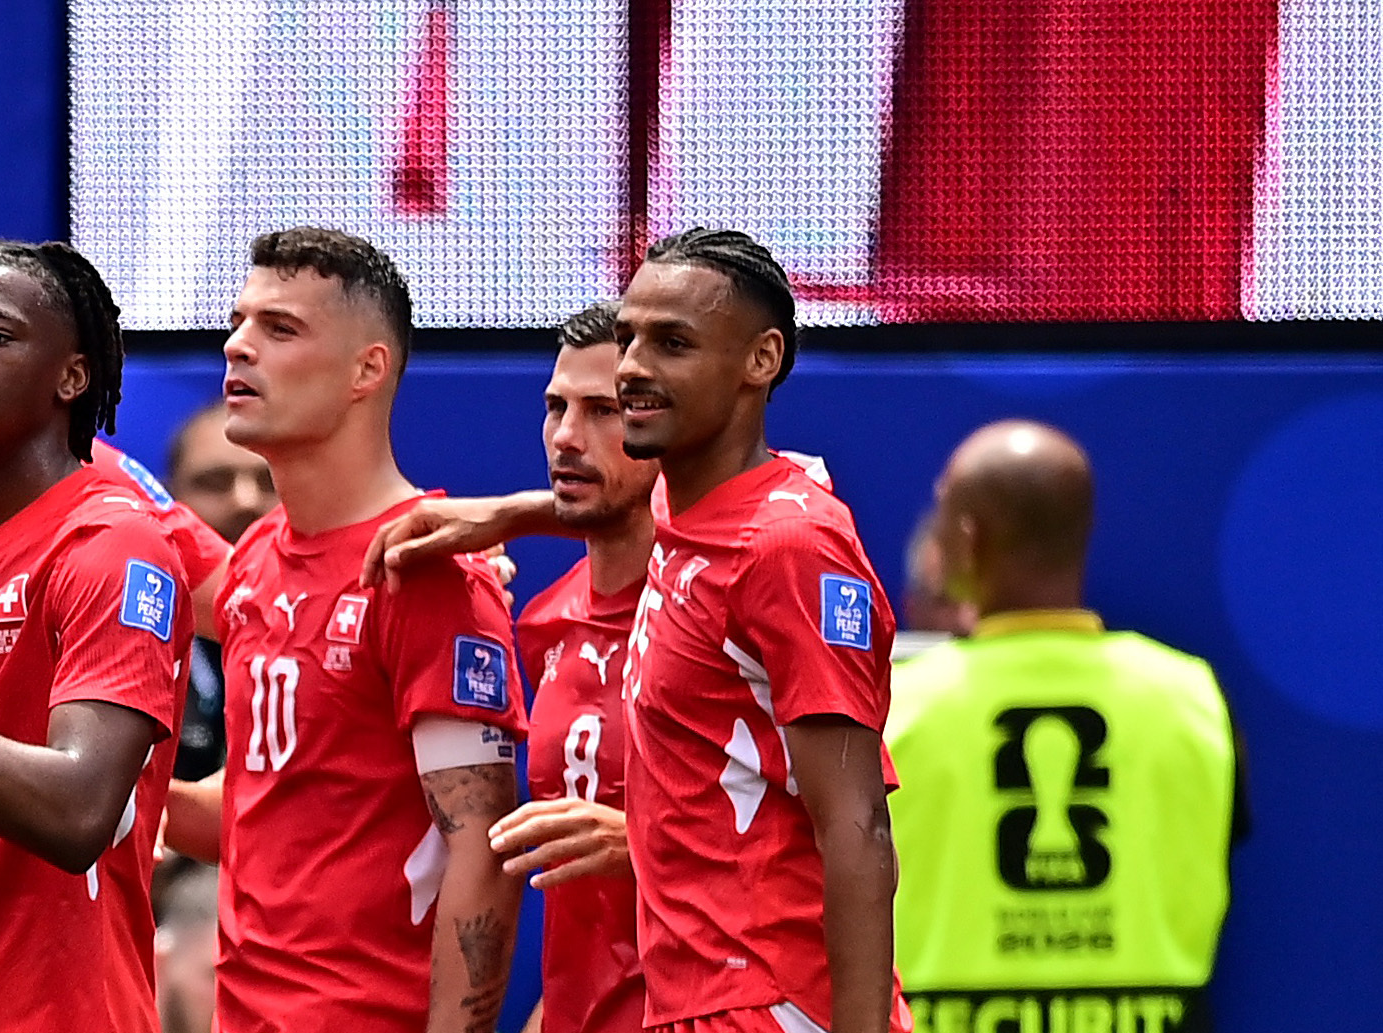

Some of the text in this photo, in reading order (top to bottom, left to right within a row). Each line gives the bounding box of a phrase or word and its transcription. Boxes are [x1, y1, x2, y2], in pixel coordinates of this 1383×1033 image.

[137, 601, 164, 624] PEACE
[836, 617, 861, 634] PEACE
[244, 655, 301, 773] 10
